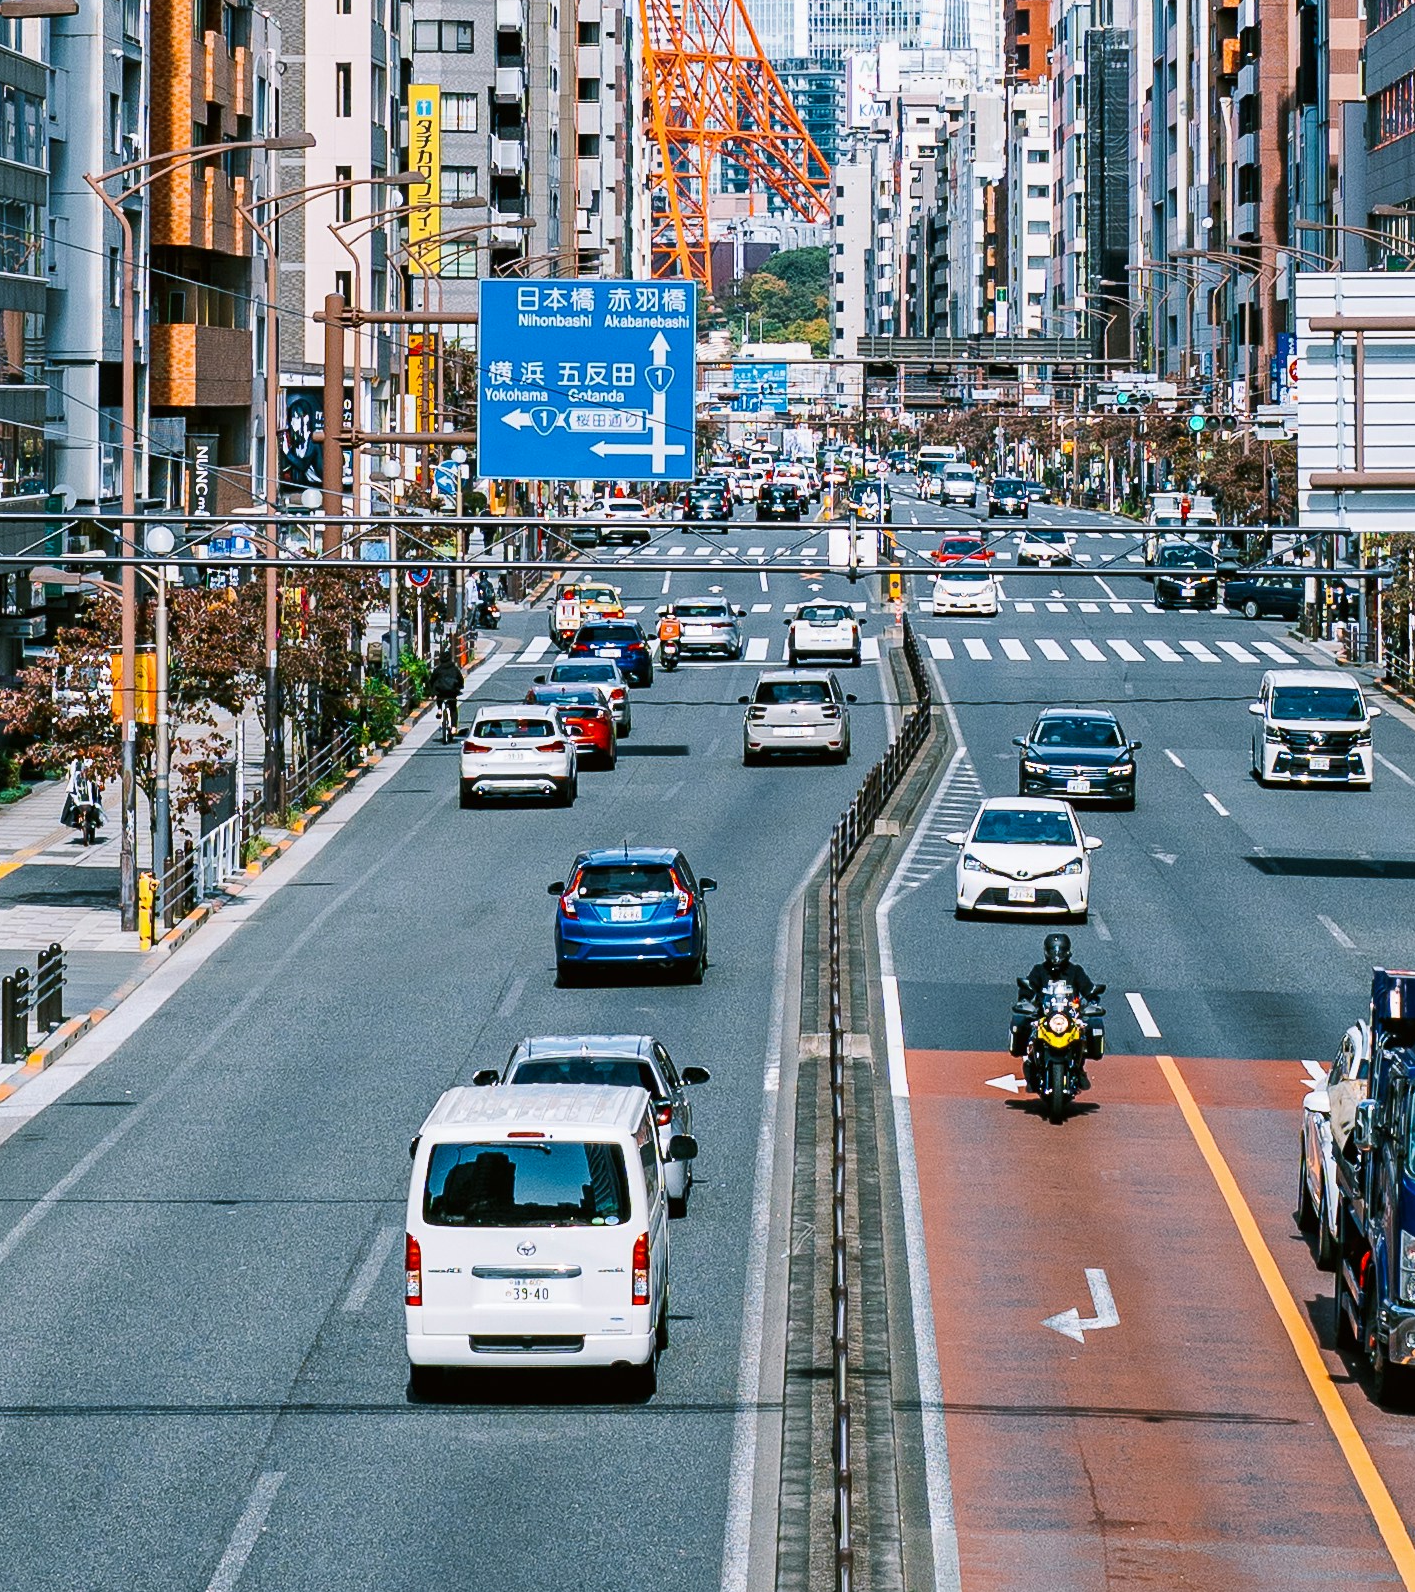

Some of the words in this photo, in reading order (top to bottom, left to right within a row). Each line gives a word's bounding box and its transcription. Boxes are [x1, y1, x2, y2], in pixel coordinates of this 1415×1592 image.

[517, 287, 595, 312] 日本橋
[607, 287, 687, 312] 赤羽橋
[518, 314, 592, 327] Nihonbashi
[604, 315, 689, 329] Akabanebashi
[488, 361, 545, 386] 横浜
[557, 362, 636, 386] 五反田
[654, 369, 664, 385] 1
[485, 388, 548, 402] Yokohama
[568, 389, 625, 403] Gotanda
[539, 411, 548, 427] 1
[575, 413, 639, 428] 桜田通り
[195, 445, 209, 496] NUNC
[513, 1287, 549, 1300] 39-40
